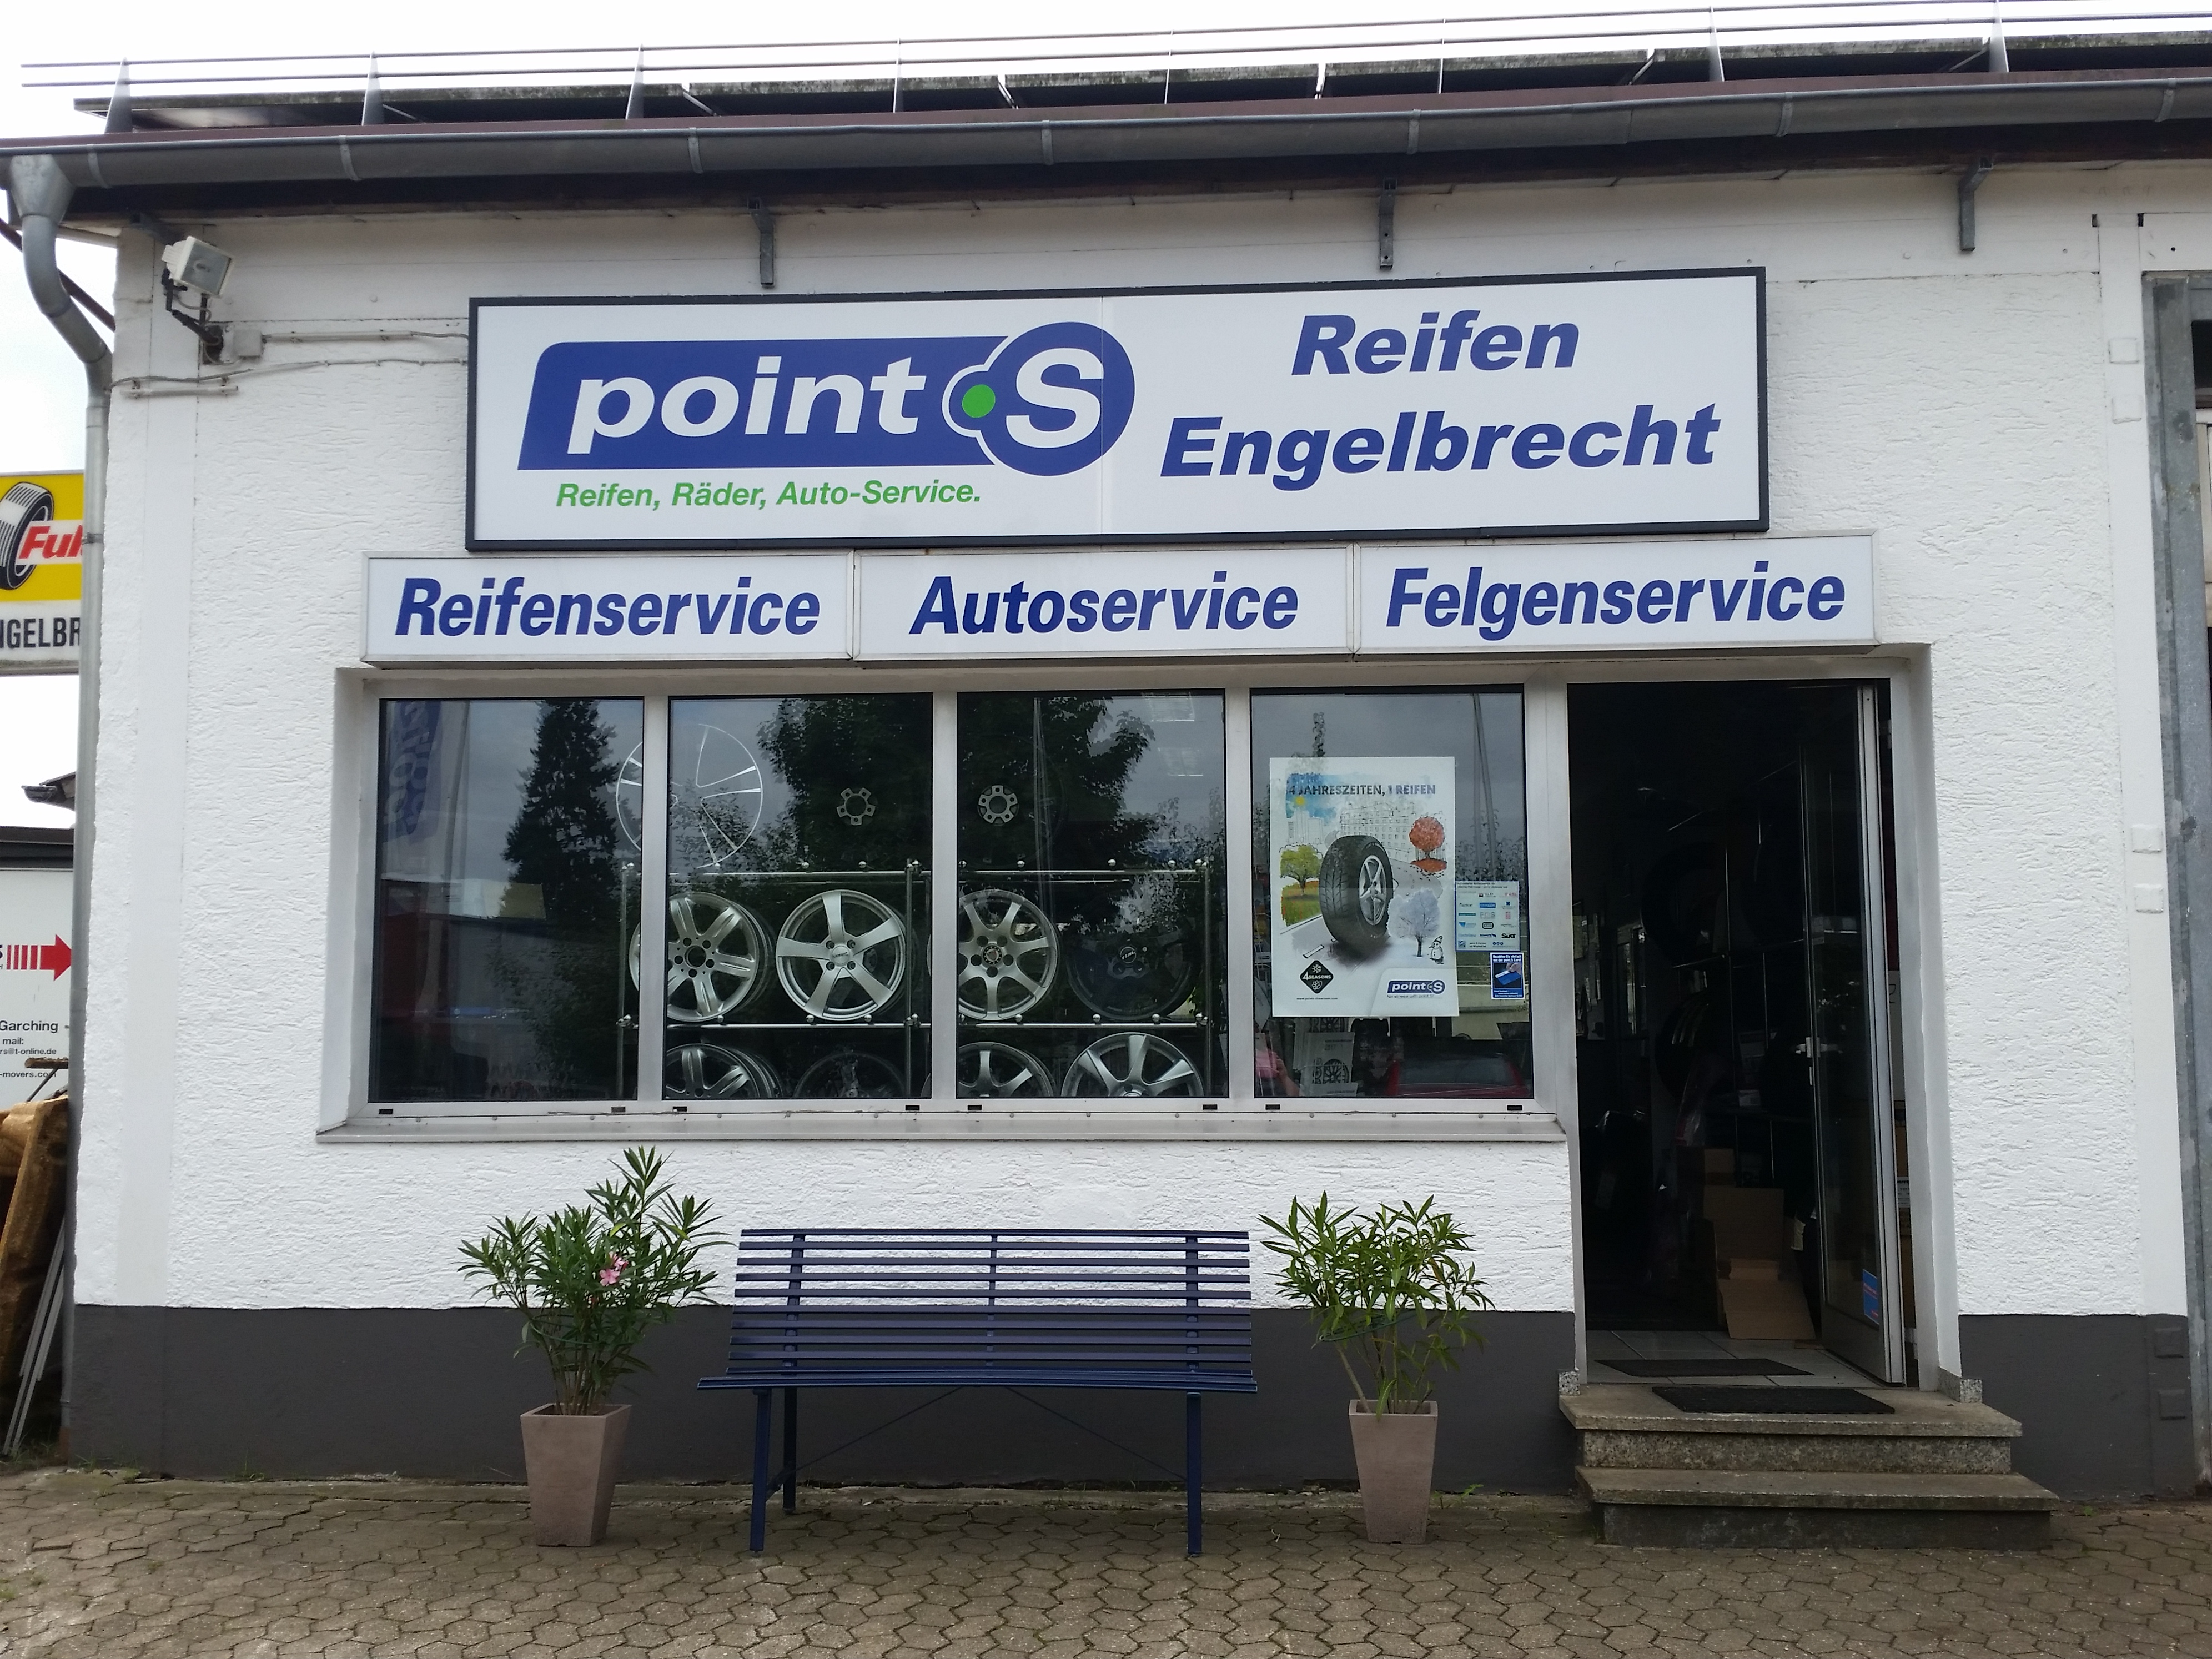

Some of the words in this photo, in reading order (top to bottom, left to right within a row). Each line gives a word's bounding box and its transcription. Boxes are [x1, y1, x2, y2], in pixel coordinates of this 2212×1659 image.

[1291, 309, 1580, 375] Reifen
[566, 355, 928, 455] point
[1004, 346, 1105, 449] S
[1160, 403, 1721, 491] Engelbrecht
[557, 482, 660, 510] Reifen,
[672, 481, 767, 509] Räder,
[776, 479, 981, 506] Auto-Service.
[19, 525, 83, 559] Ful
[395, 575, 821, 637] Reifenservice
[908, 570, 1299, 635] Autoservice
[1386, 560, 1845, 641] Felgenservice
[0, 617, 79, 649] GELBR
[1298, 785, 1385, 796] JAHRESZEITEN,
[1395, 785, 1436, 795] REIFEN
[1391, 982, 1426, 992] point
[1432, 982, 1443, 992] S
[0, 1020, 58, 1033] Garching
[2, 1037, 24, 1045] mail:
